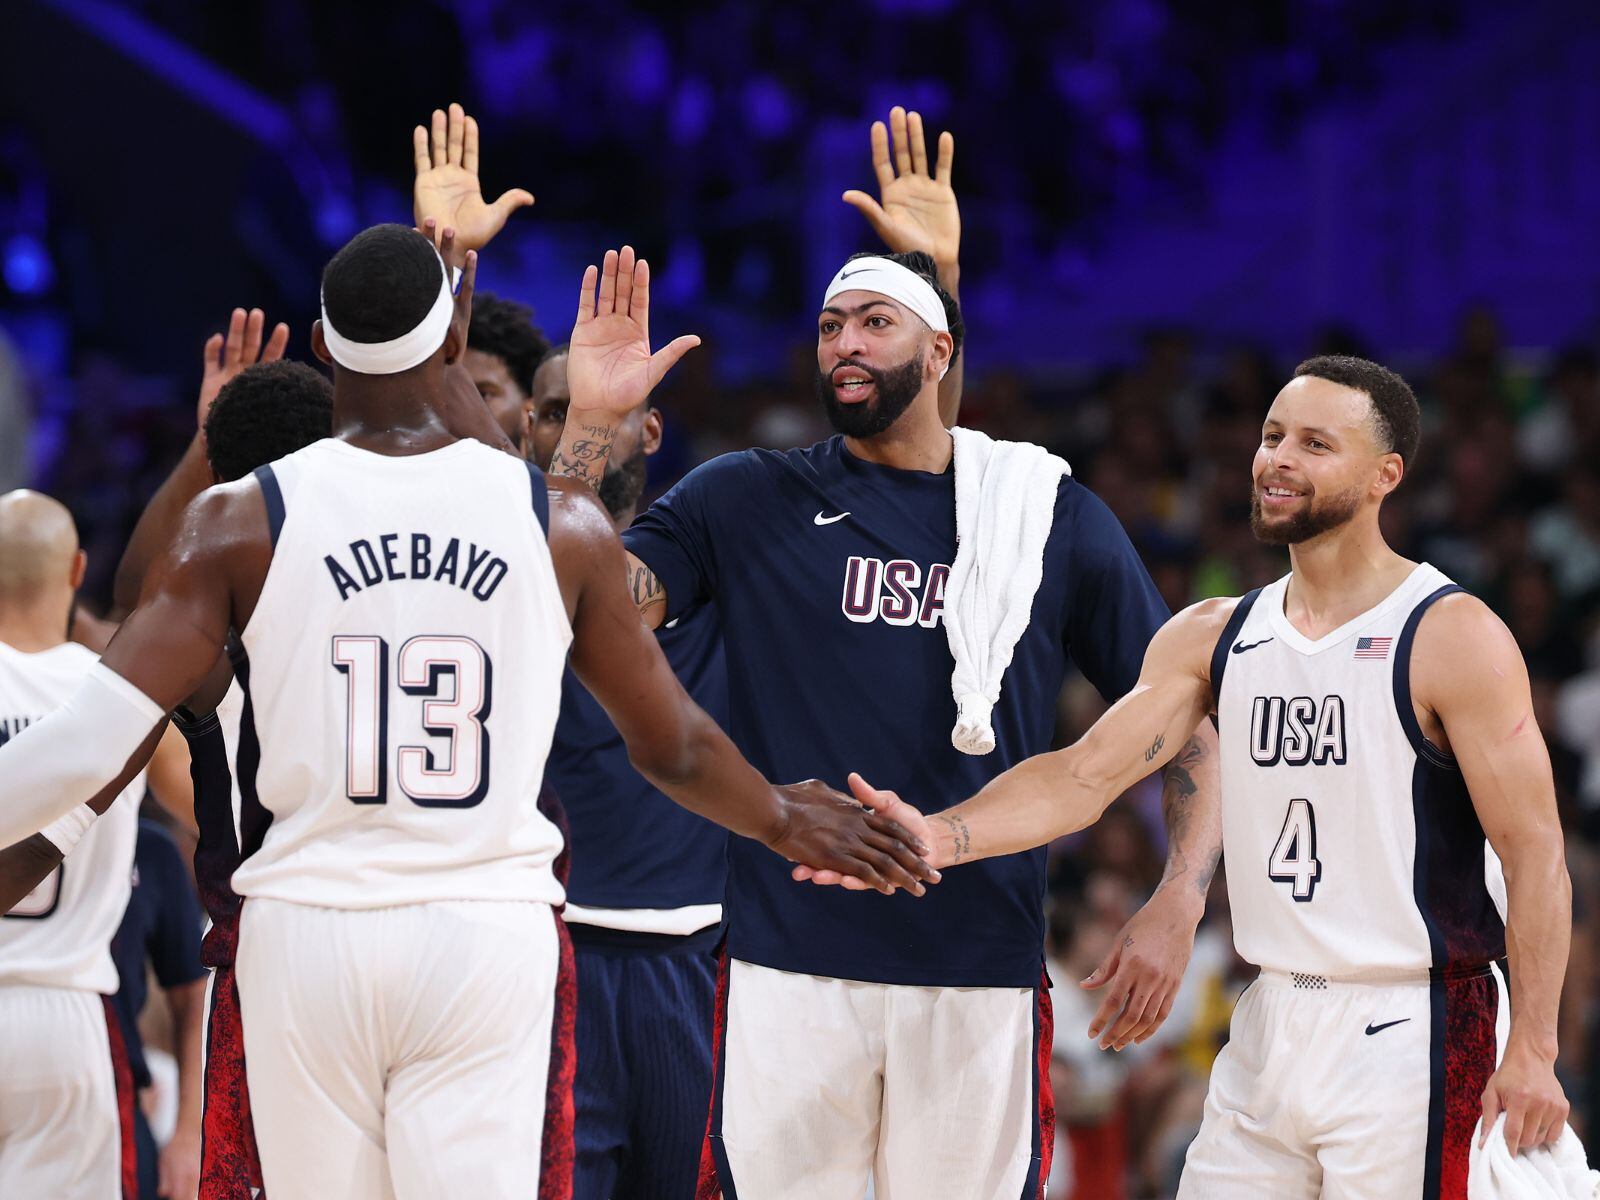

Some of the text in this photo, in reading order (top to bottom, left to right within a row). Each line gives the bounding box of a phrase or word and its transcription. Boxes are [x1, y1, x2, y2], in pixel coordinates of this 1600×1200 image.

[324, 533, 508, 601] ADEBAYO
[332, 635, 493, 809] 13
[1250, 695, 1347, 766] USA
[1268, 799, 1322, 902] 4
